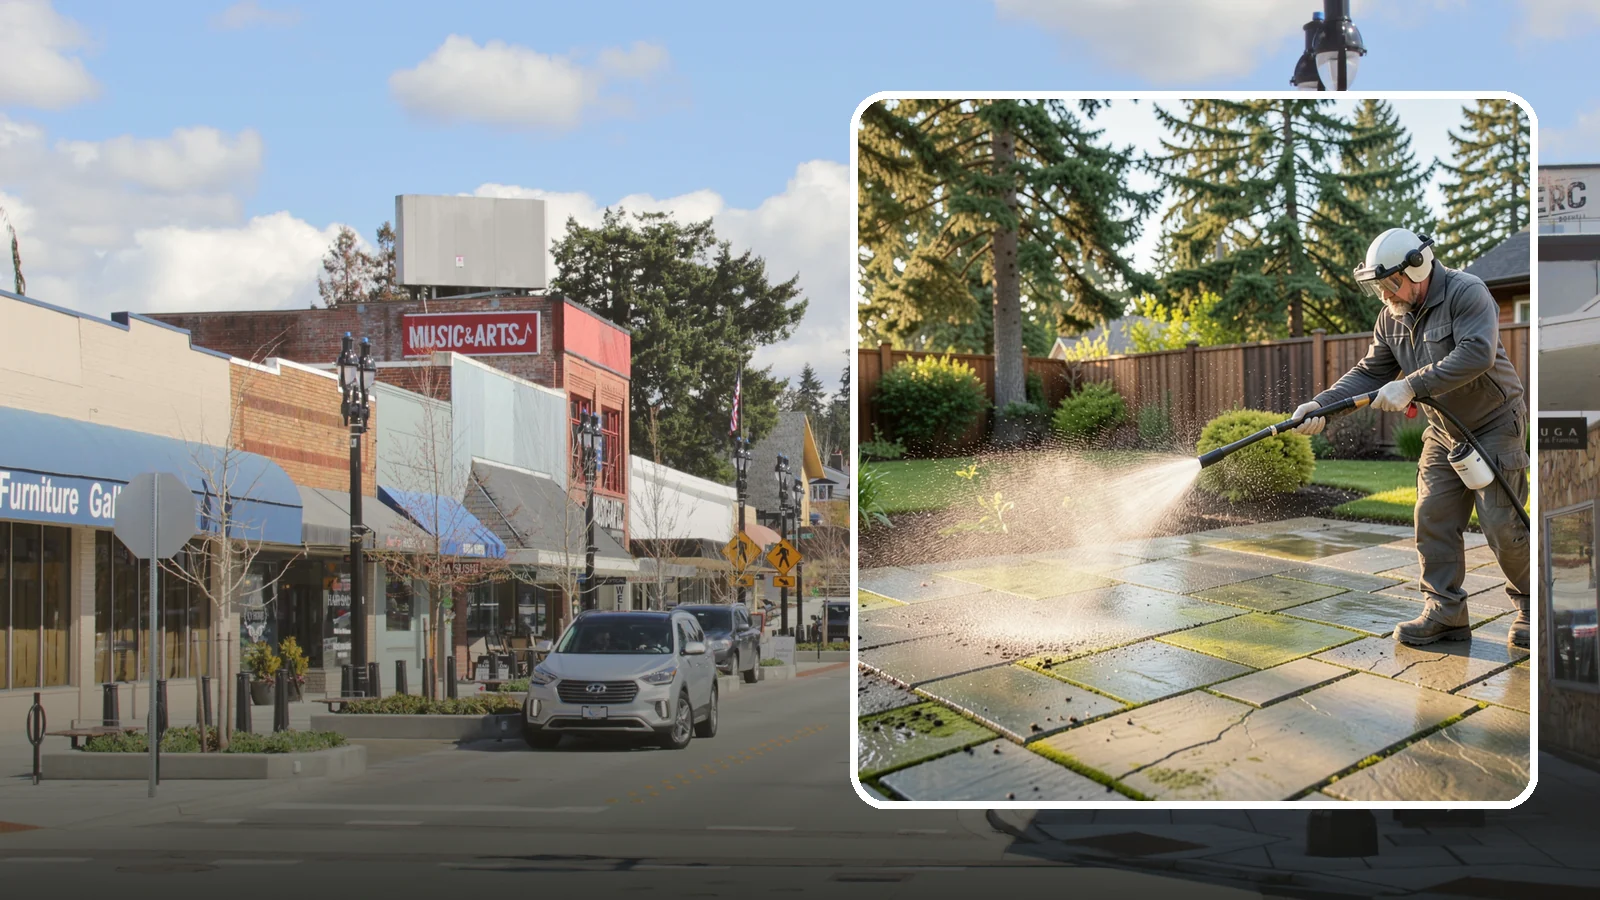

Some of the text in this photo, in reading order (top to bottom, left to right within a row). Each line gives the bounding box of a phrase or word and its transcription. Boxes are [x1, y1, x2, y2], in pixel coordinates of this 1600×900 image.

[409, 322, 519, 349] MUSIC&ARTS
[0, 471, 79, 515] Furniture
[453, 563, 479, 574] SUSHI
